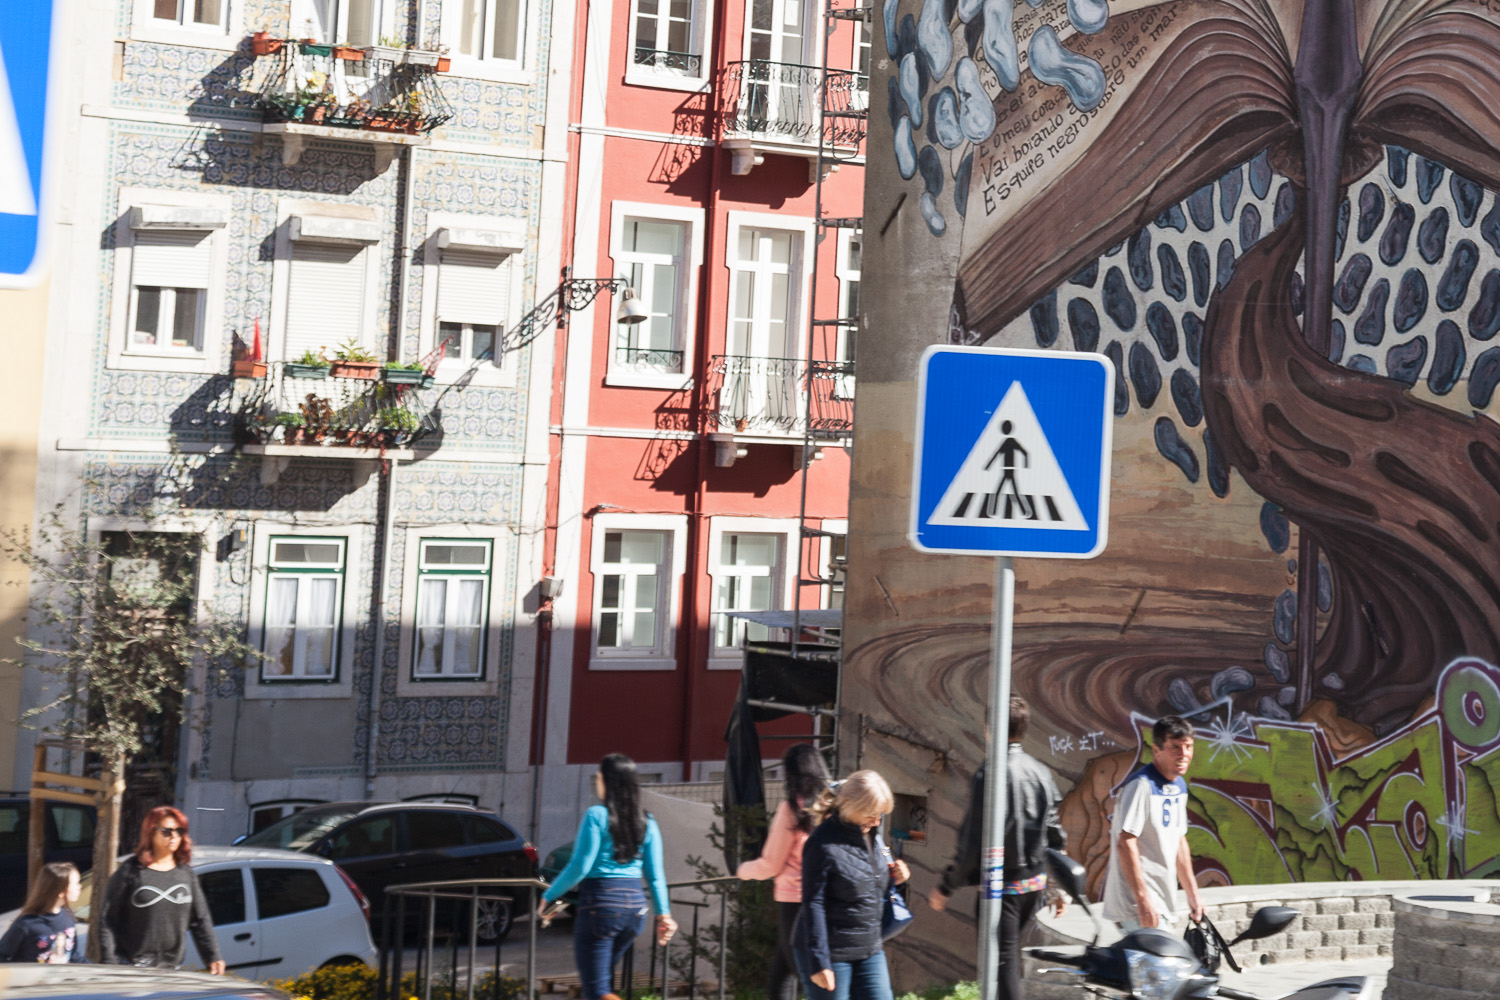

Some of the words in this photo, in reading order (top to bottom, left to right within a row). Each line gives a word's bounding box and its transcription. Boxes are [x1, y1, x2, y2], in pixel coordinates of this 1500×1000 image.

[981, 151, 1009, 185] Vai
[1012, 114, 1064, 162] boiando
[982, 153, 1045, 216] Esquife
[1046, 114, 1090, 158] negro
[1149, 4, 1178, 42] mar
